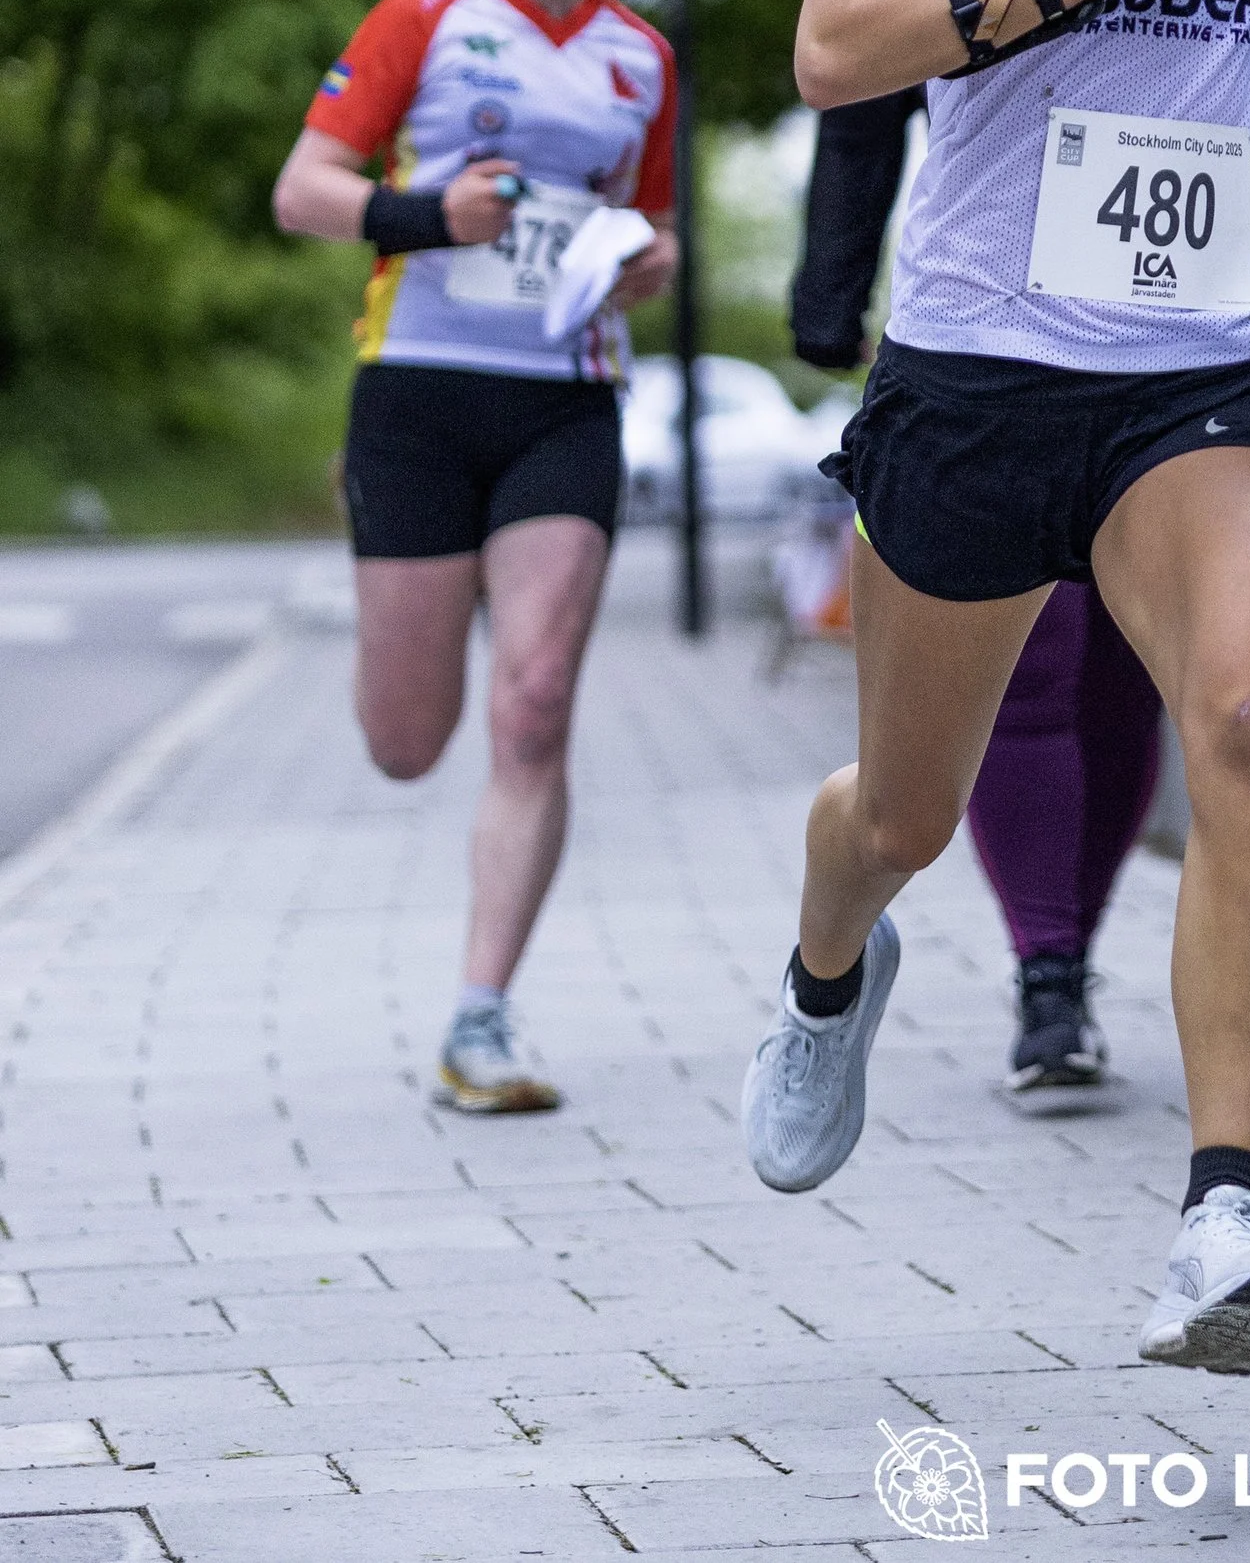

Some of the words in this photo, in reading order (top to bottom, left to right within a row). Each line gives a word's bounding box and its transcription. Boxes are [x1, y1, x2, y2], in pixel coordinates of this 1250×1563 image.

[1118, 131, 1181, 150] Stockholm
[1184, 138, 1204, 156] City
[1206, 140, 1224, 157] Cup
[1225, 142, 1243, 157] 2025
[1097, 165, 1215, 249] 480
[1133, 251, 1177, 279] ICA
[1154, 278, 1177, 289] nära
